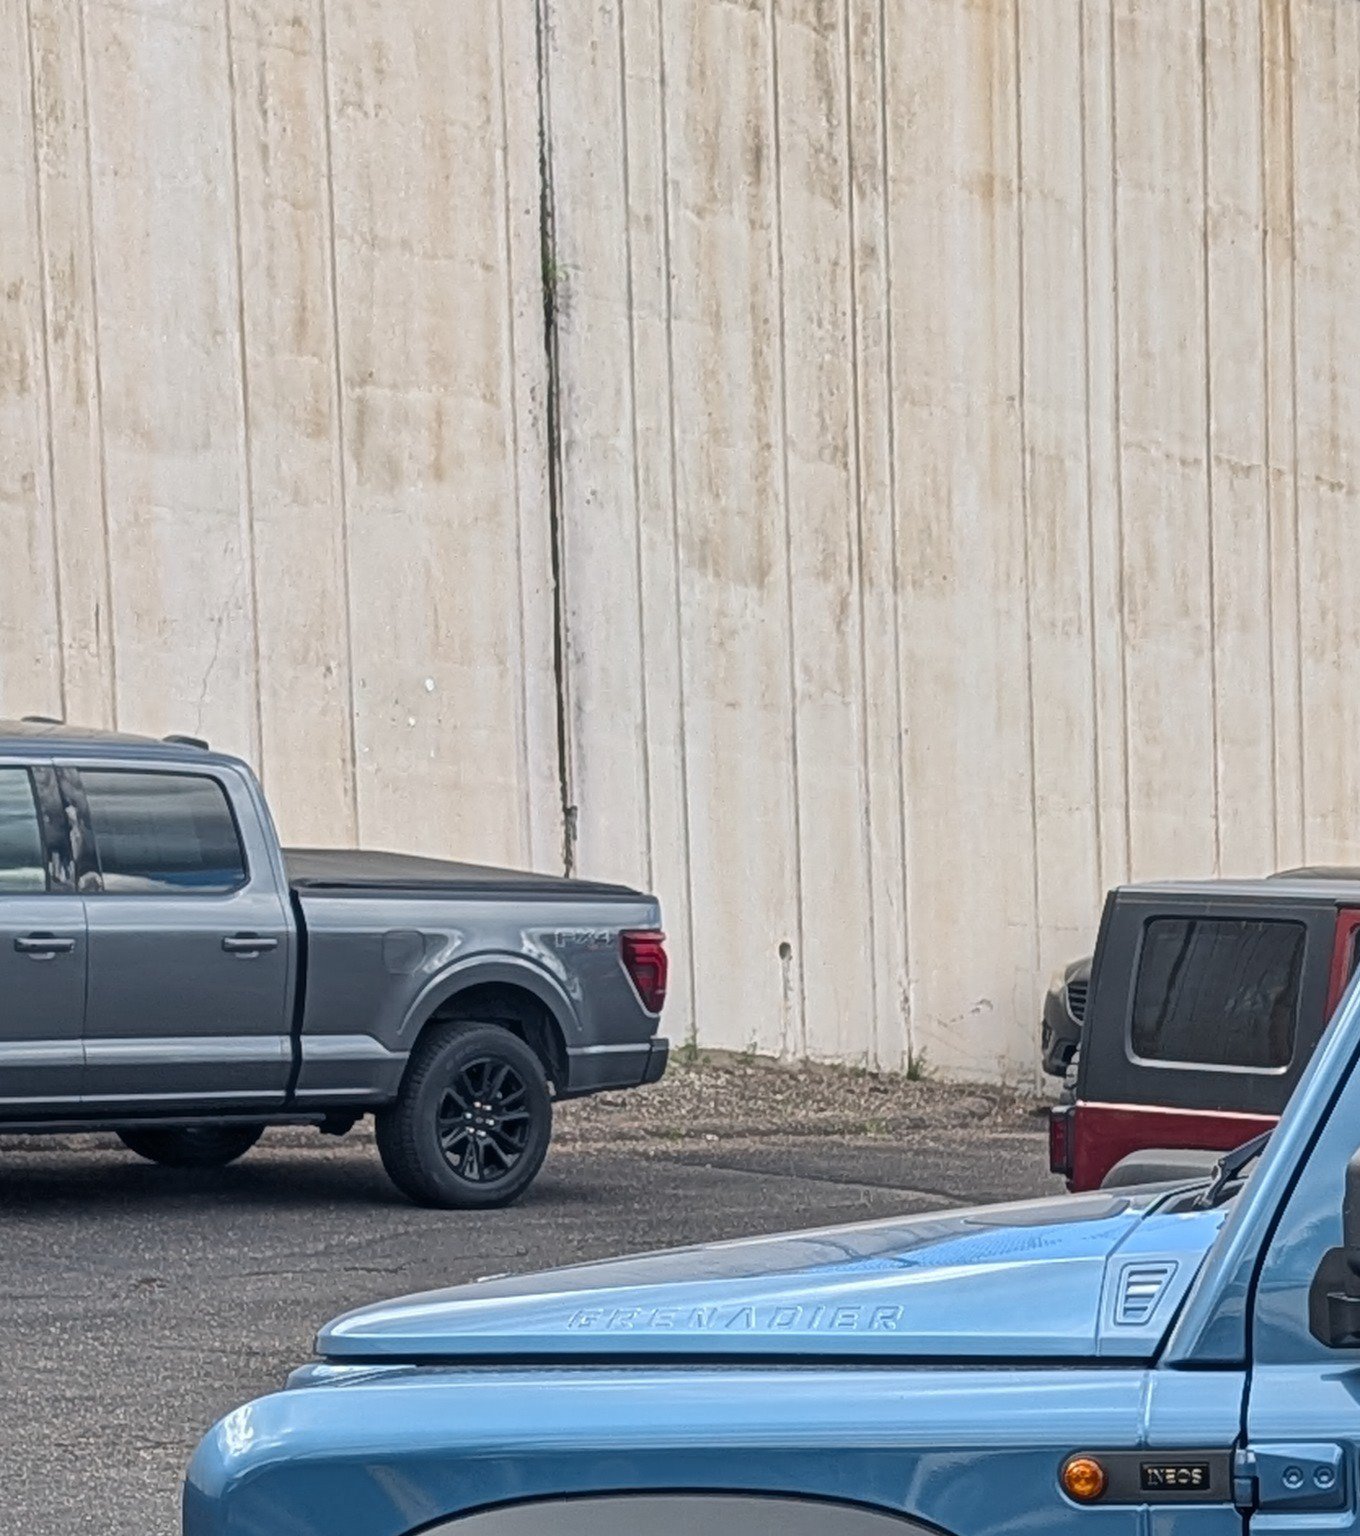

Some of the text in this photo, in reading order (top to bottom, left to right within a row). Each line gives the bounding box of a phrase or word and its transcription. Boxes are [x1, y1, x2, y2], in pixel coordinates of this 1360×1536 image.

[555, 929, 614, 948] FX4
[565, 1304, 904, 1331] GRENADIER
[1146, 1467, 1203, 1486] INEOS
